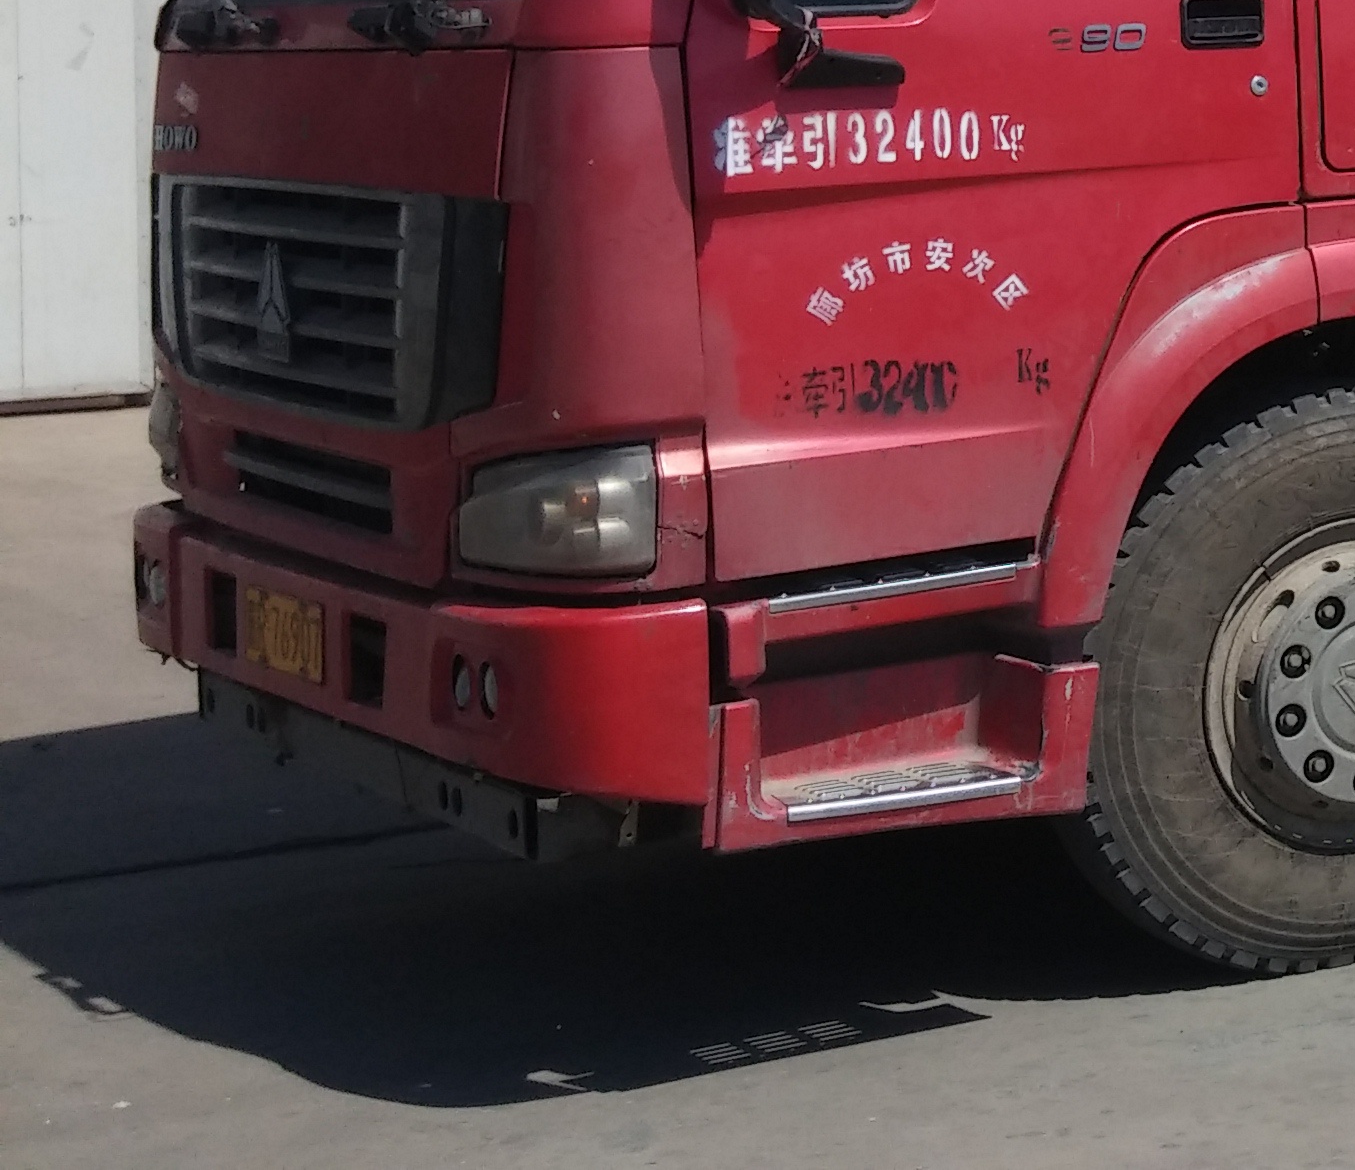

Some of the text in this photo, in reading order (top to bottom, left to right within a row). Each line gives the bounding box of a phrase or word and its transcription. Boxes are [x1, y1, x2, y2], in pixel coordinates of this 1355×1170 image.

[154, 124, 198, 151] HOWO
[806, 237, 1029, 326] 廊坊市安次区
